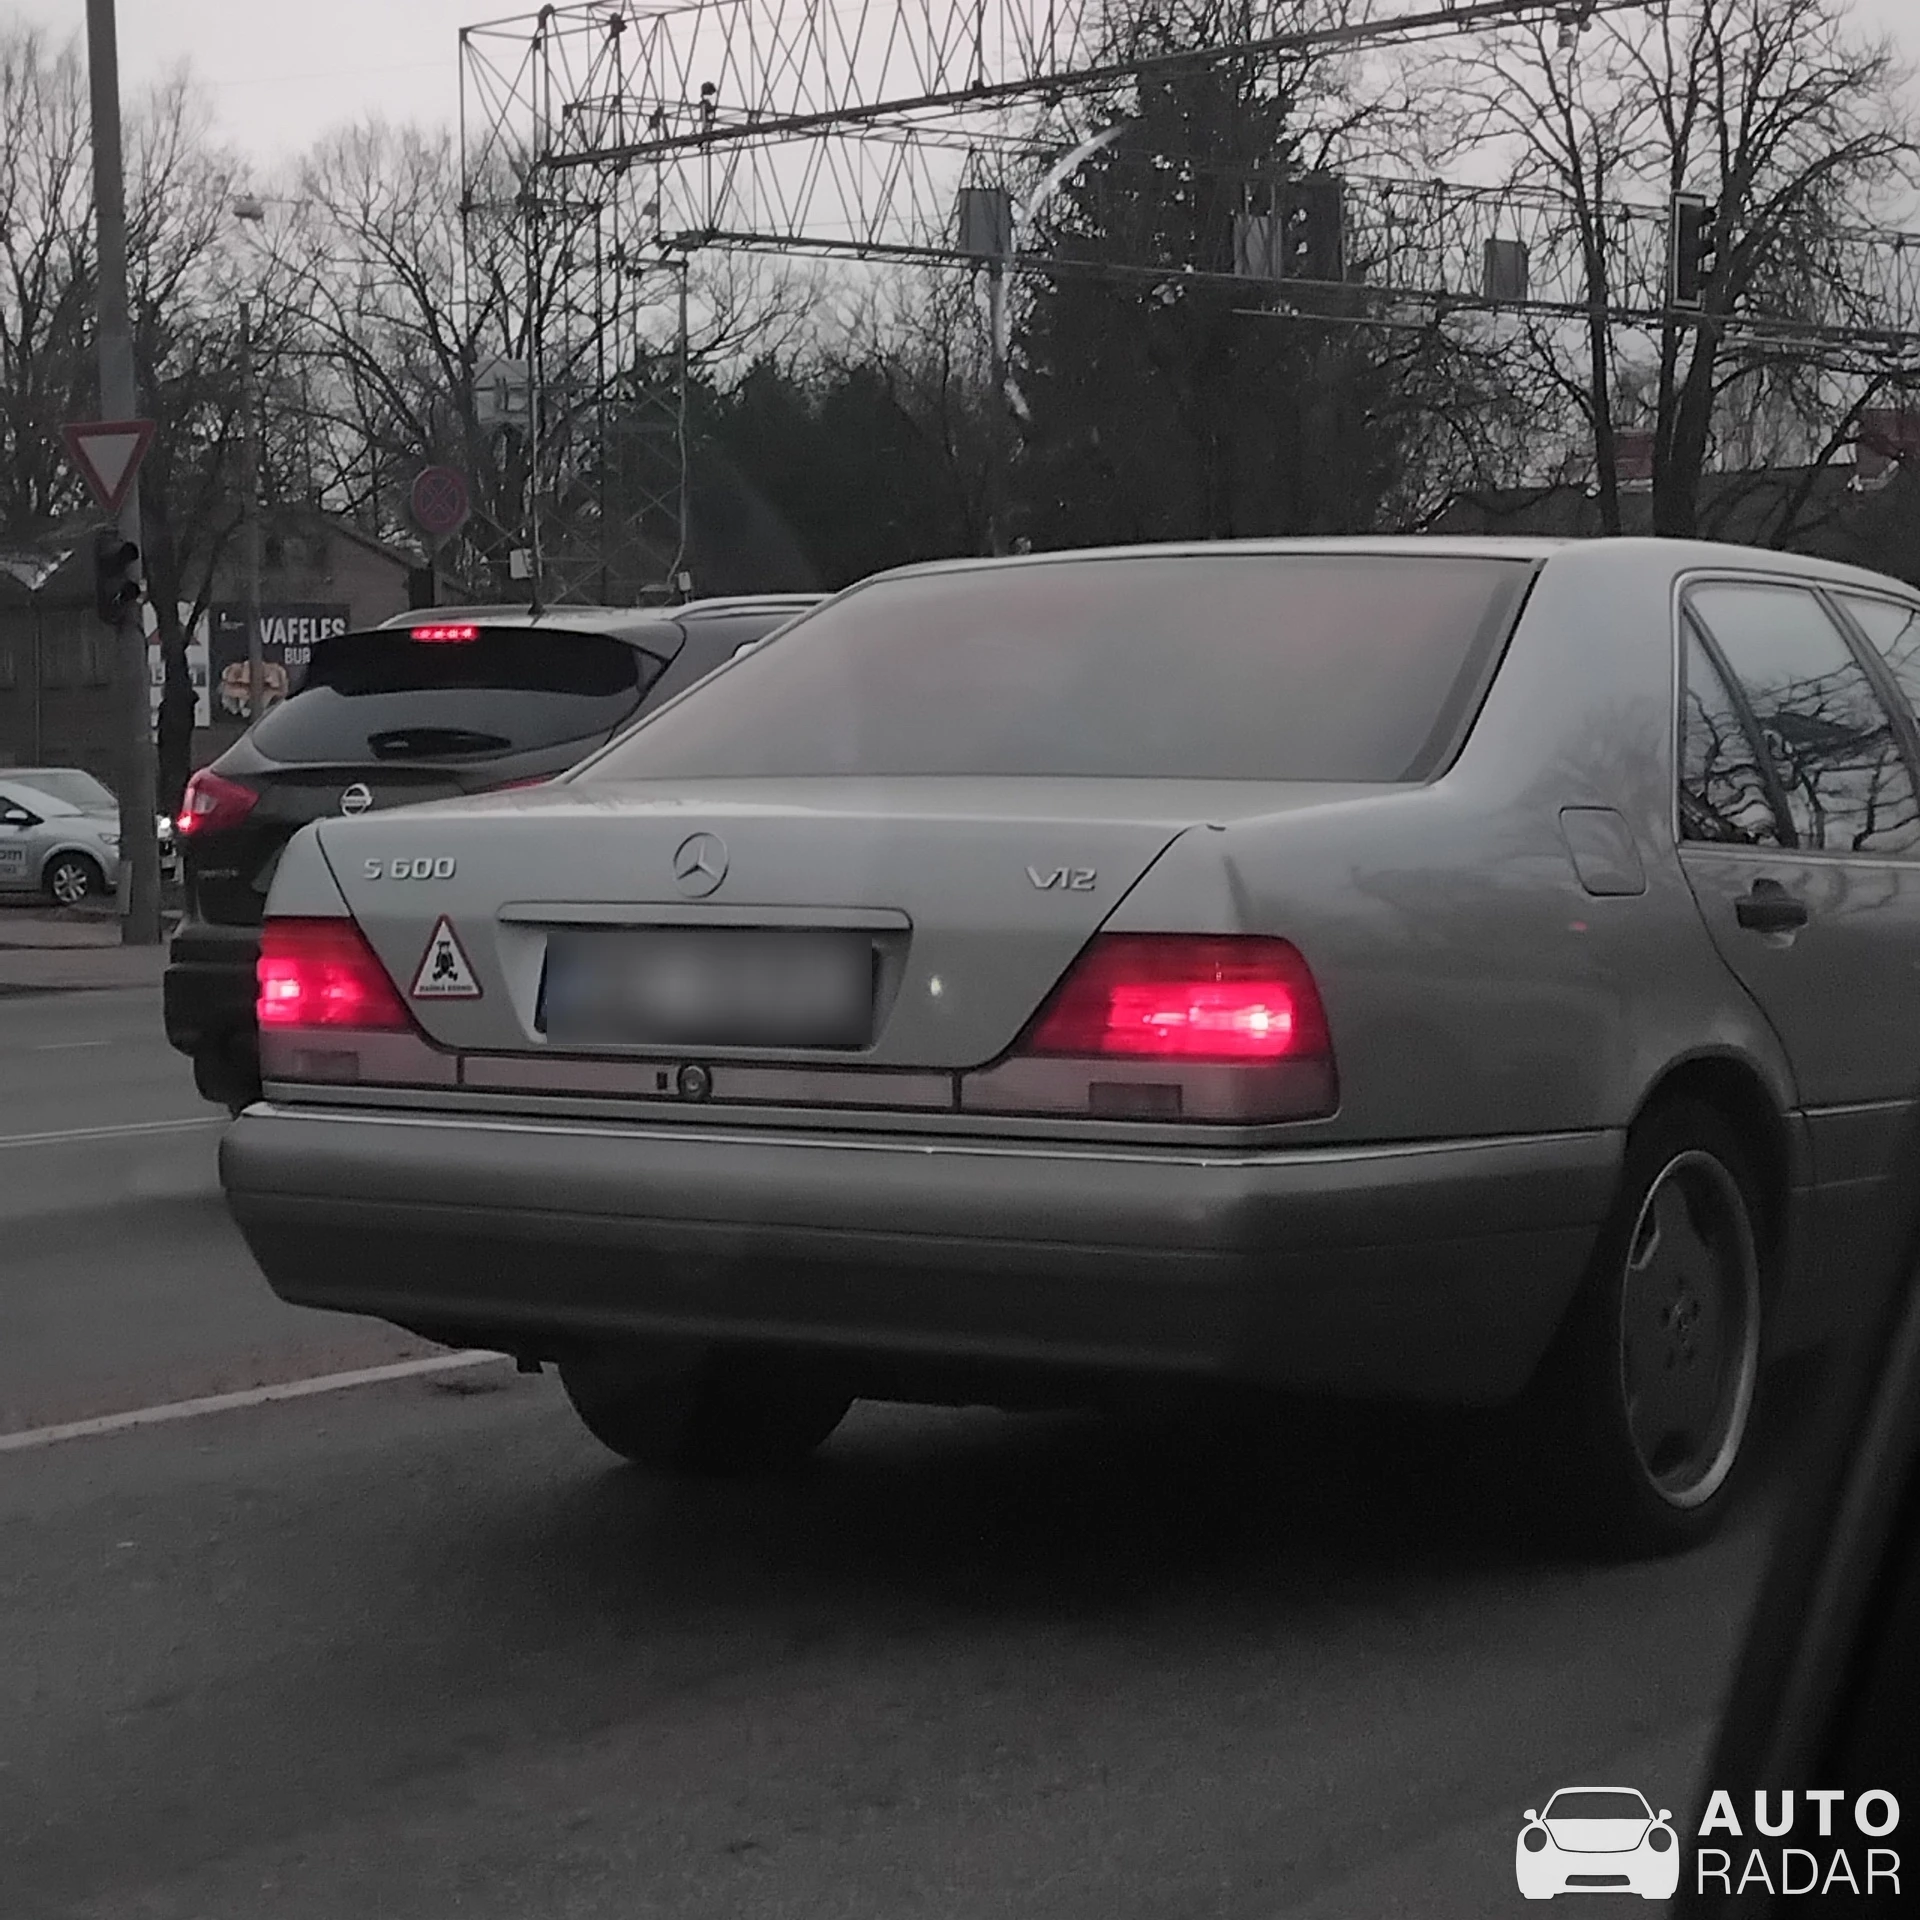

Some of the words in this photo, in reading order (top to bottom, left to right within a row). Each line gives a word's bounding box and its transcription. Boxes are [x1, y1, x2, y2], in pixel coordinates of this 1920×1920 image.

[260, 617, 346, 644] VAFELES
[363, 858, 382, 880] S
[390, 857, 456, 880] 600
[1025, 865, 1097, 891] V12
